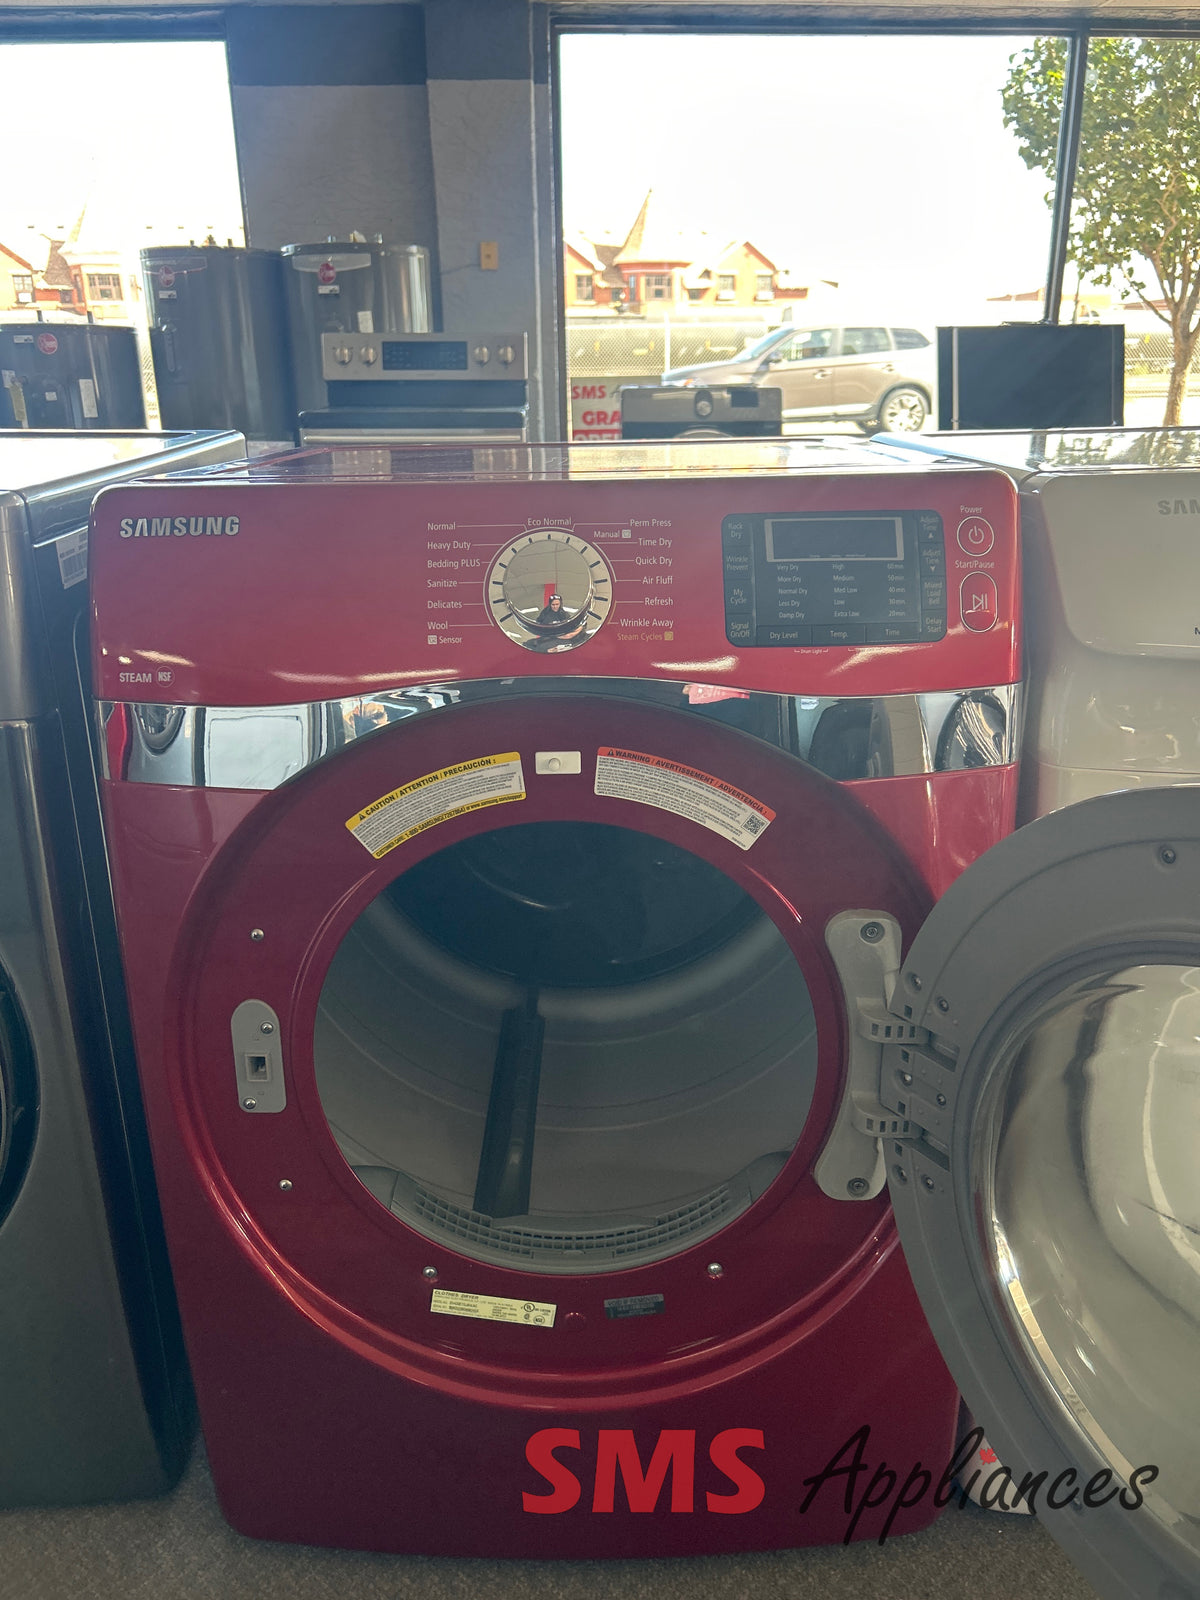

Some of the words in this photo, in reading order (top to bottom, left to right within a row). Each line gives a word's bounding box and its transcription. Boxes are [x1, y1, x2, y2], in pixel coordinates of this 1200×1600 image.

[572, 385, 606, 399] SMS
[960, 505, 982, 513] Power
[527, 518, 541, 526] Eco
[544, 516, 571, 526] Normal
[630, 519, 650, 527] Perm
[652, 519, 672, 527] Press
[119, 516, 240, 538] SAMSUNG
[427, 522, 456, 531] Normal
[594, 530, 621, 538] Manual
[427, 542, 451, 551] Heavy
[453, 541, 472, 550] Duty
[638, 538, 657, 546] Time
[659, 538, 672, 548] Dry
[427, 560, 459, 570] Bedding
[461, 559, 480, 568] PLUS
[635, 557, 657, 566] Quick
[660, 557, 672, 567] Dry
[955, 559, 995, 569] Start/Pause
[427, 579, 458, 588] Sanitize
[642, 576, 654, 585] Air
[655, 575, 673, 585] Fluff
[427, 600, 463, 609] Delicates
[644, 596, 674, 606] Refresh
[427, 620, 448, 630] Wool
[620, 618, 650, 628] Wrinkle
[651, 618, 674, 629] Away
[617, 632, 639, 641] Steam
[640, 632, 663, 642] Cycles
[769, 631, 781, 640] Dry
[782, 631, 798, 639] Level
[885, 628, 900, 636] Time
[439, 635, 463, 644] Sensor
[119, 672, 152, 682] STEAM
[157, 670, 172, 681] NSF
[615, 749, 651, 763] WARNING
[655, 759, 715, 785] AVERTISSEMENT
[718, 783, 764, 813] ADVERTENCIA
[365, 794, 396, 816] CAUTION
[399, 773, 439, 797] ATTENTION
[443, 757, 492, 777] PRECAUCIÓN
